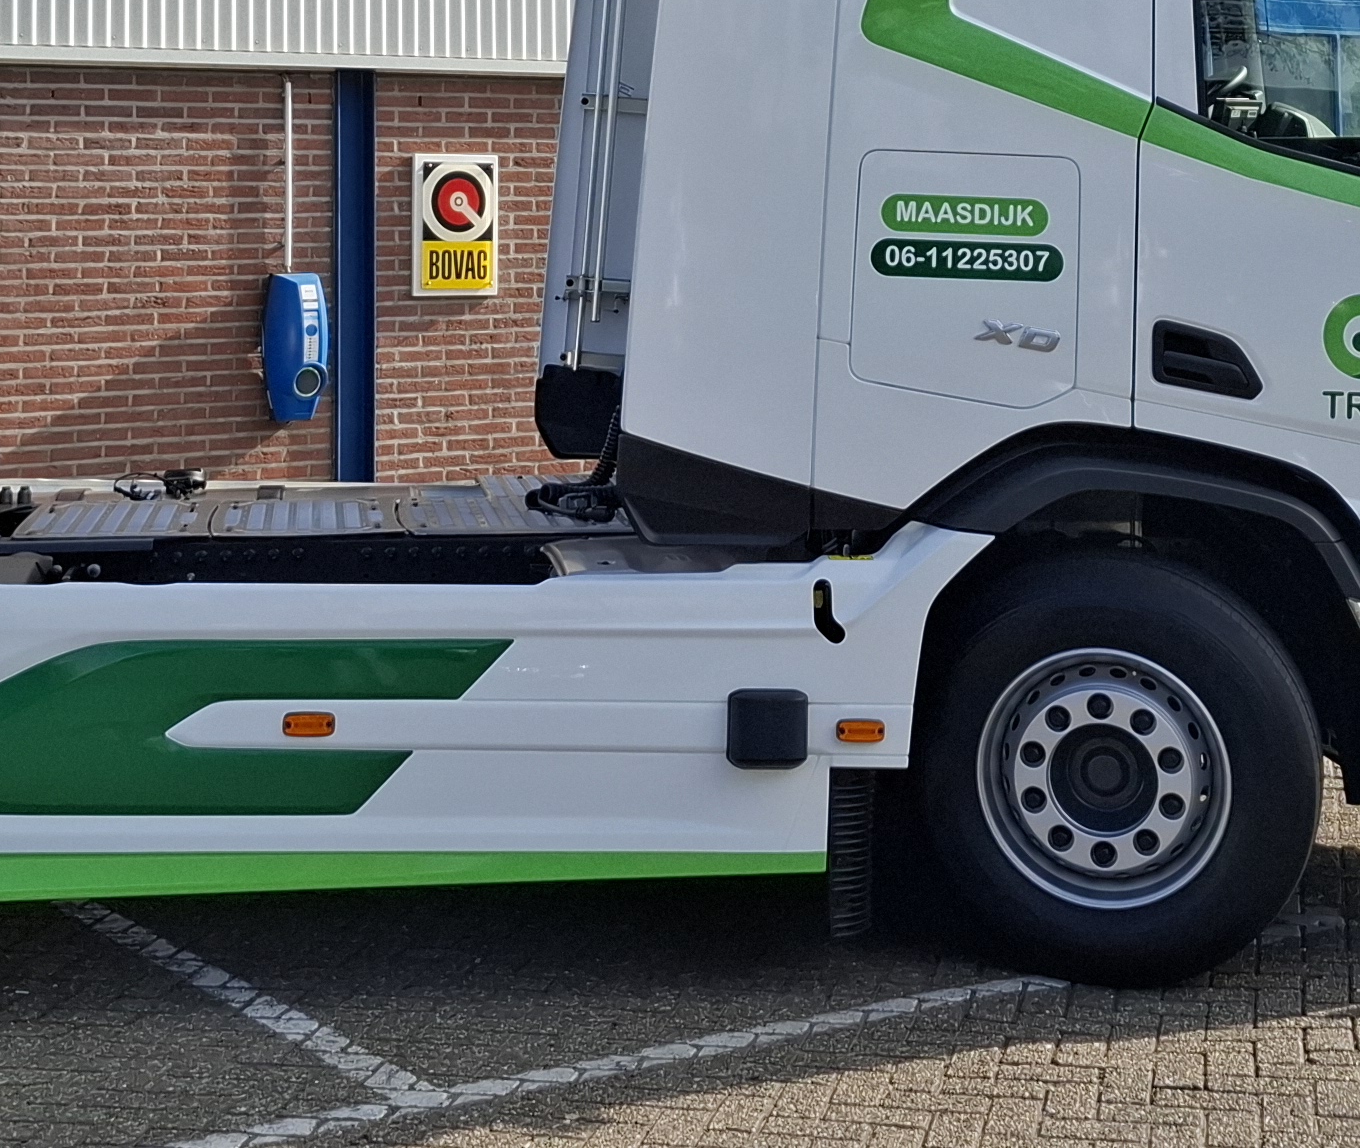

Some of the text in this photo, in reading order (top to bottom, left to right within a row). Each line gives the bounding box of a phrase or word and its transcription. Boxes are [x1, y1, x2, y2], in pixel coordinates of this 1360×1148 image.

[896, 201, 1033, 226] MAASDIJK
[429, 249, 488, 280] BOVAG
[885, 245, 1050, 272] 06-11225307
[974, 319, 1061, 353] XD
